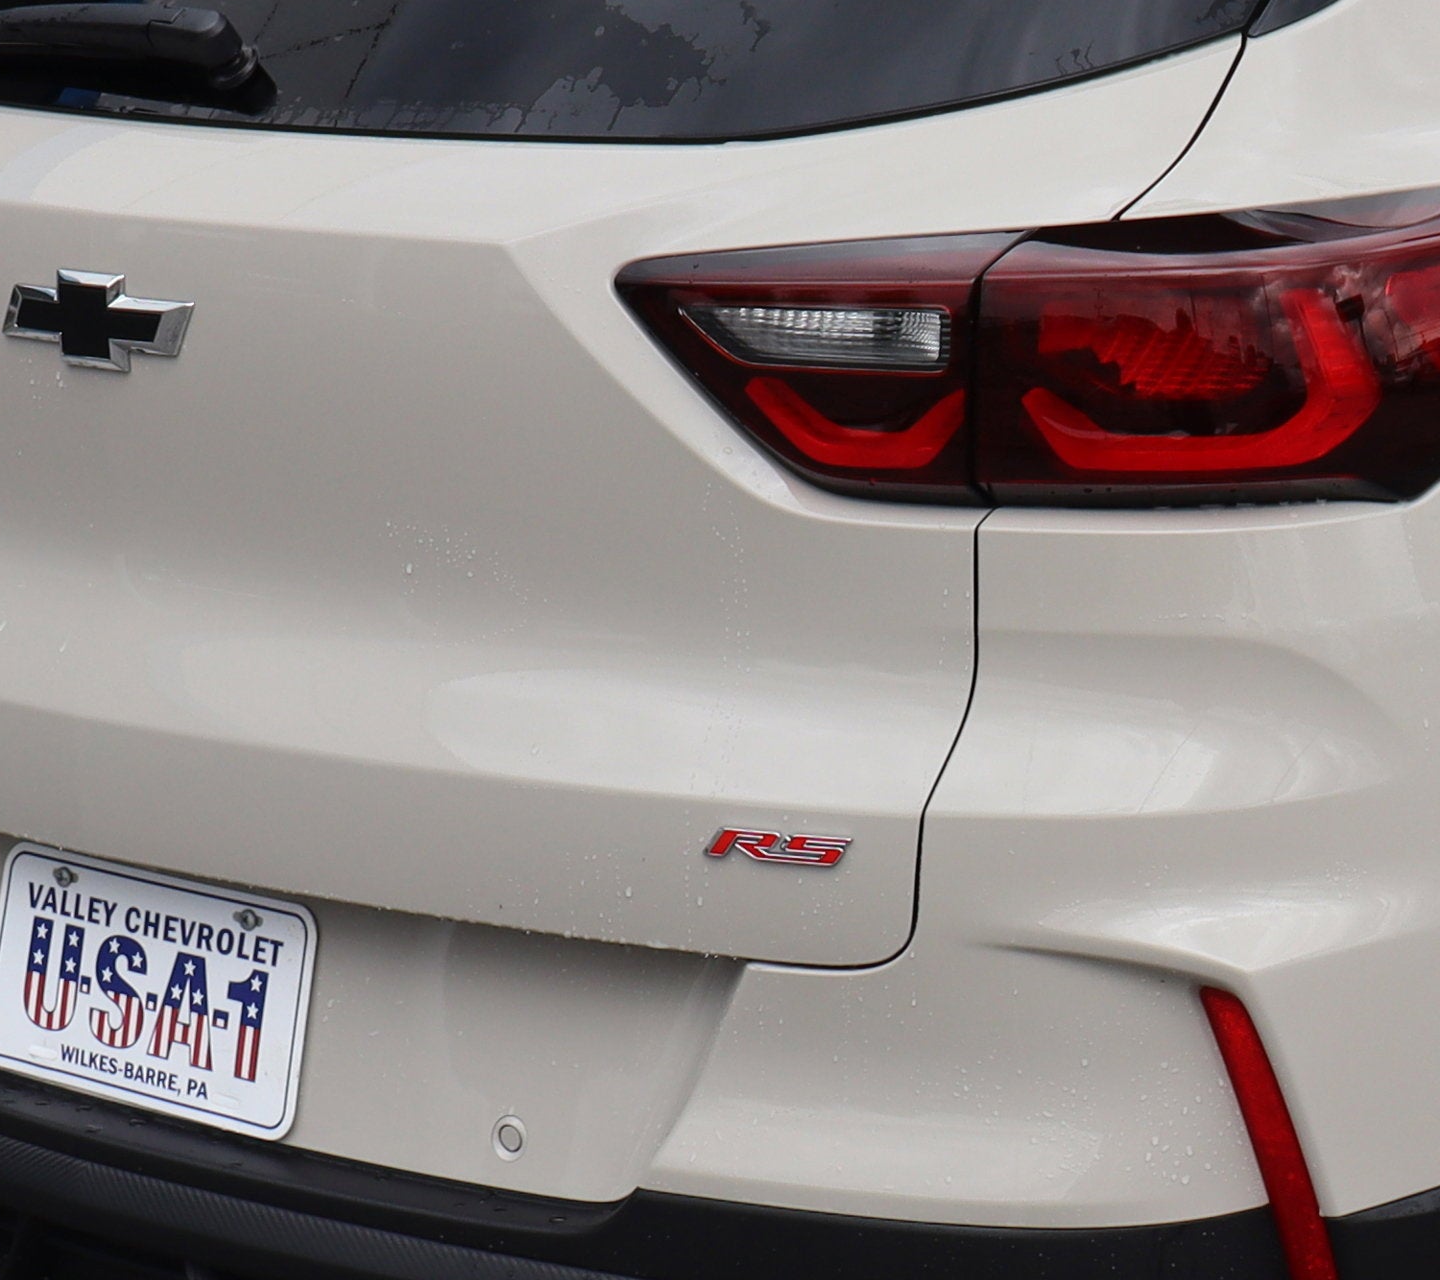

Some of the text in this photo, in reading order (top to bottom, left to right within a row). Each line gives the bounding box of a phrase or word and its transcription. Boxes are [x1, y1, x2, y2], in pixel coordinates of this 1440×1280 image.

[703, 826, 854, 867] RS
[28, 881, 284, 967] VALLEY CHEVROLET
[60, 1043, 208, 1100] WILKES-BARRE, PA
